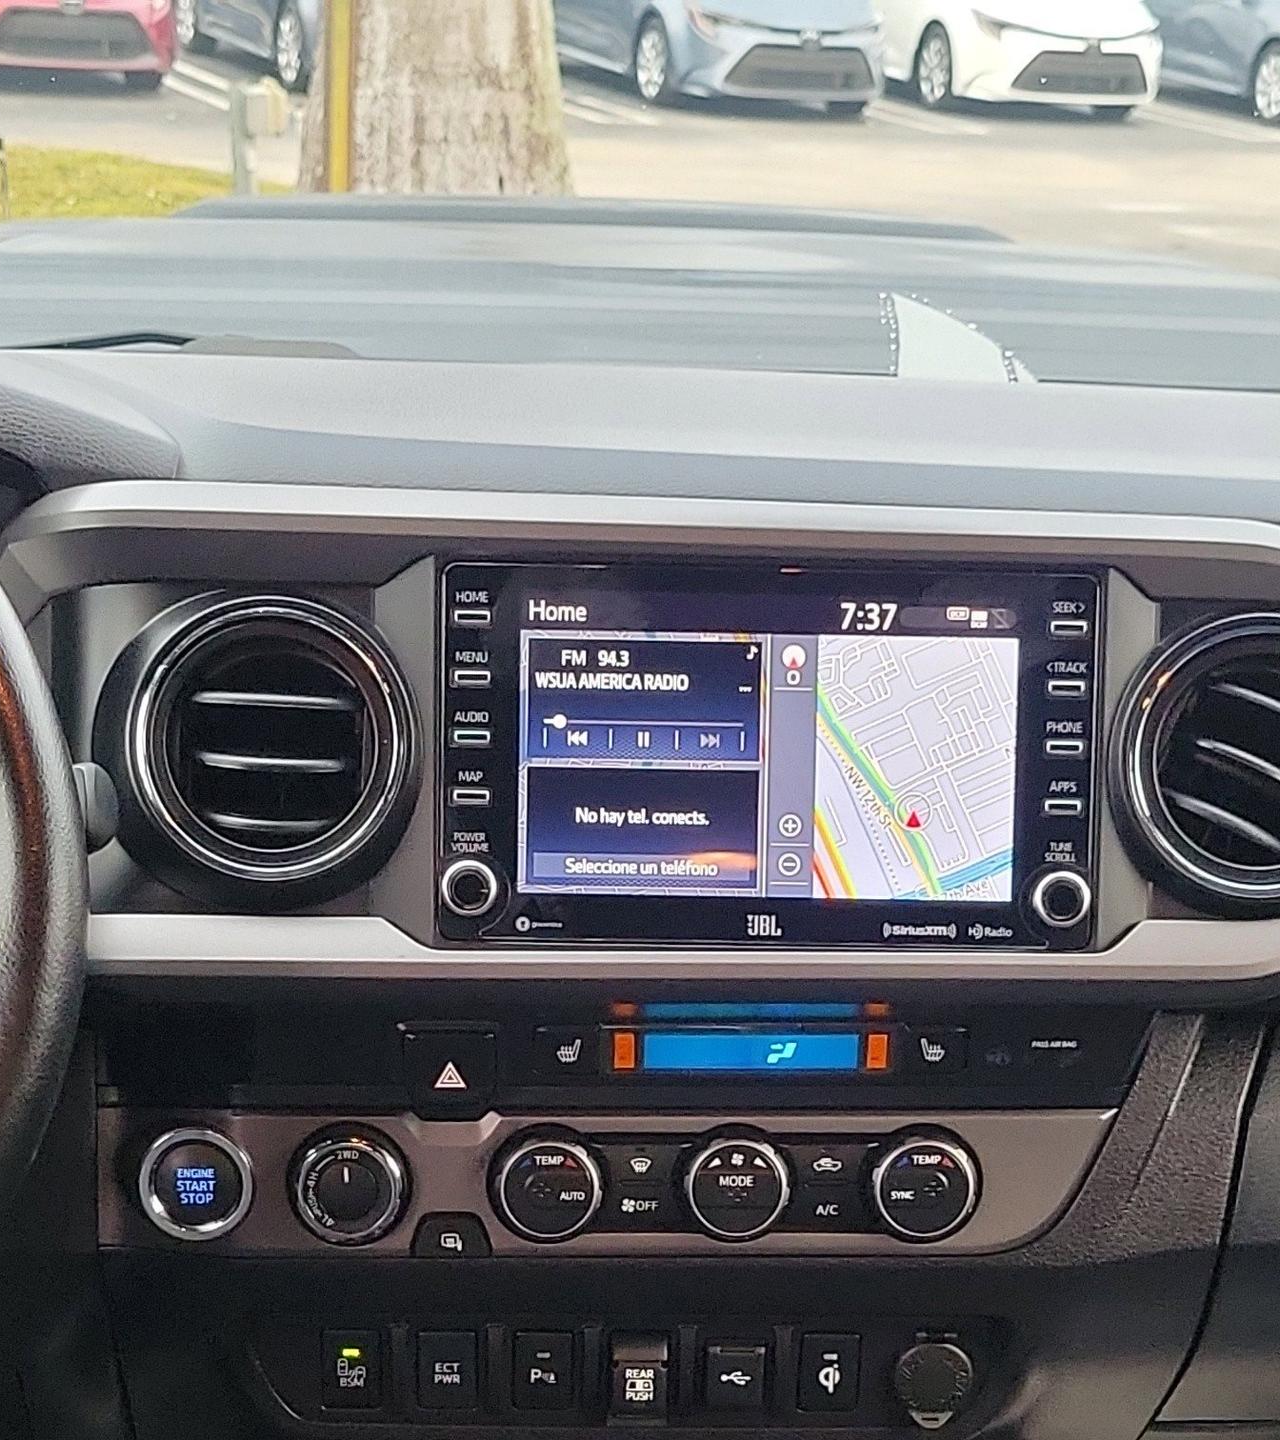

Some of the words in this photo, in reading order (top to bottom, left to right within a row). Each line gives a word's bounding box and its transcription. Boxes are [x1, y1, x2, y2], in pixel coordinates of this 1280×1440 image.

[455, 591, 489, 604] HOME
[528, 599, 588, 623] Home
[840, 602, 898, 632] 7:37
[455, 651, 489, 664] MENU
[561, 650, 587, 667] FM
[597, 649, 630, 668] 94.3
[535, 671, 577, 690] WSUA
[578, 672, 643, 691] AMERICA
[643, 674, 690, 692] RADIO
[453, 711, 490, 724] AUDIO
[1046, 721, 1084, 734] PHONE
[458, 771, 484, 783] MAP
[845, 766, 867, 789] NW
[1049, 781, 1078, 794] APPS
[575, 807, 599, 825] No
[599, 807, 626, 828] hay
[627, 809, 651, 826] tel.
[651, 811, 711, 827] conects.
[453, 831, 487, 843] POWER
[451, 842, 490, 853] VOLUME
[1049, 842, 1073, 853] TUNE
[1044, 852, 1076, 864] SCROLL
[564, 857, 637, 875] Seleccione
[638, 863, 659, 876] un
[659, 858, 719, 878] teléfono
[747, 914, 782, 938] JBL
[984, 926, 1013, 938] Radio
[336, 1149, 360, 1161] 2WD
[533, 1155, 565, 1166] TEMP
[911, 1154, 942, 1166] TEMP
[176, 1167, 216, 1179] ENGINE
[176, 1180, 216, 1192] START
[719, 1175, 754, 1187] MODE
[180, 1192, 214, 1205] STOP
[559, 1190, 586, 1201] AUTO
[890, 1190, 915, 1200] SYNC
[635, 1200, 659, 1212] OFF
[815, 1203, 839, 1216] A/C
[434, 1362, 460, 1373] ECT
[625, 1368, 655, 1379] REAR
[339, 1376, 365, 1388] BSM
[434, 1374, 461, 1385] PWR
[625, 1391, 654, 1402] PUSH
